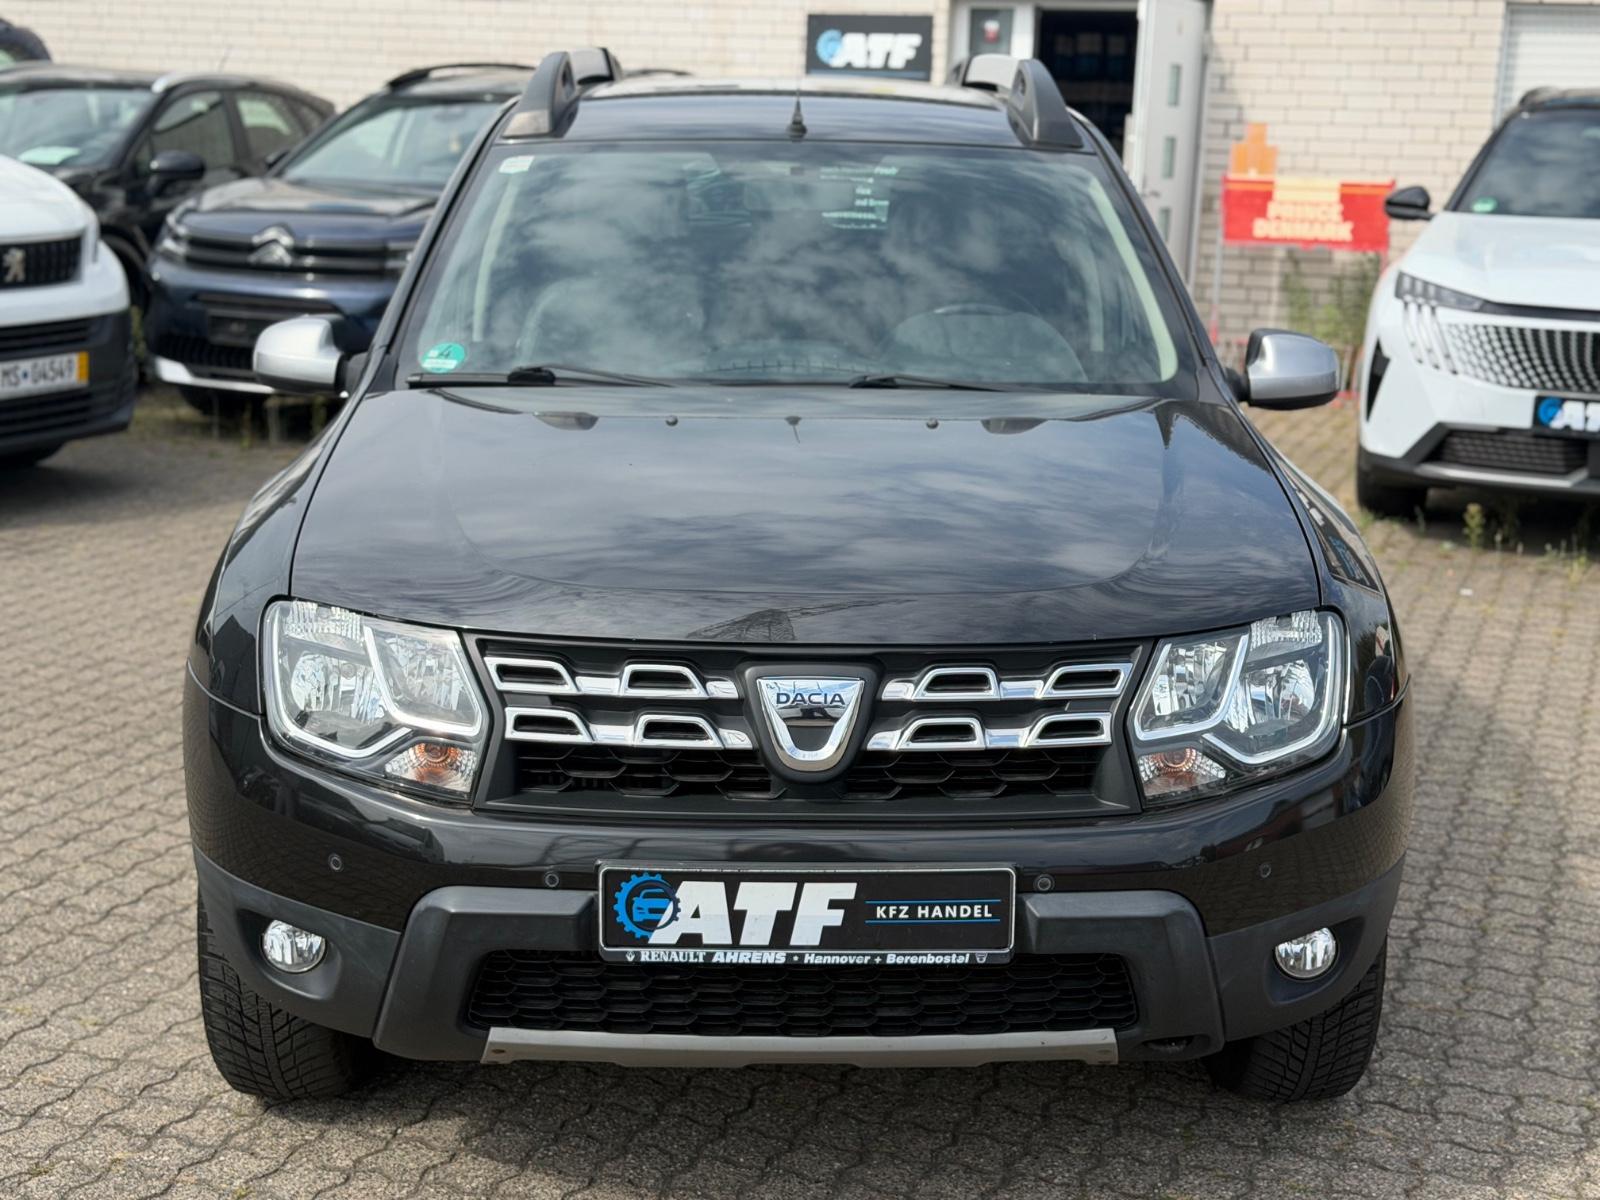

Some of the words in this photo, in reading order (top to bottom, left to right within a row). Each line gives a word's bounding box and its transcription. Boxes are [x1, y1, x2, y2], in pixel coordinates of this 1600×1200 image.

[829, 32, 923, 69] ATF
[776, 692, 846, 705] DACIA
[648, 880, 858, 946] ATF
[876, 905, 910, 919] KFZ
[917, 904, 993, 918] HANDEL
[640, 950, 706, 963] RENAULT
[711, 951, 787, 964] AHRENS
[803, 953, 871, 965] Hannover
[886, 953, 971, 965] Berenbostal
